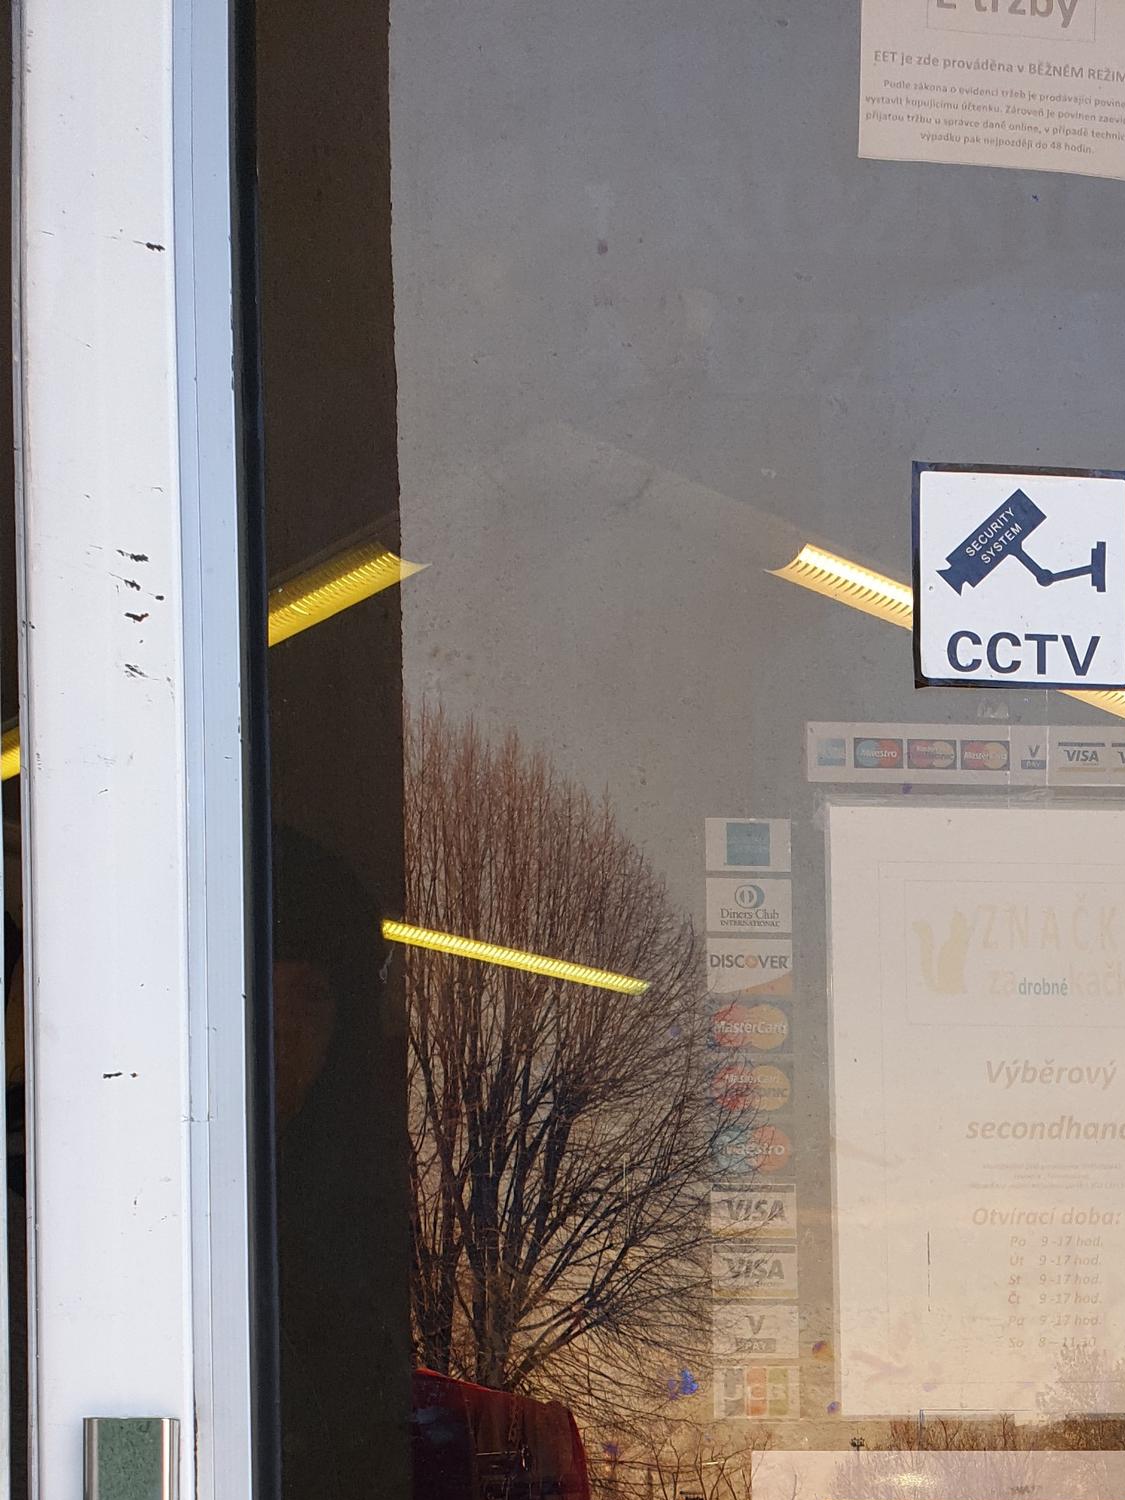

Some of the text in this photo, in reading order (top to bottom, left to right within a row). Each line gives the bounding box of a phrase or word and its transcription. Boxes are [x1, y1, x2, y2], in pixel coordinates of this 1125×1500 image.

[874, 50, 897, 64] EET
[900, 53, 914, 67] je
[916, 53, 939, 67] zde
[943, 55, 1014, 74] prováděna
[1017, 64, 1025, 73] v
[1028, 60, 1084, 79] BĚŽNÉM
[959, 85, 998, 98] evidenci
[1028, 90, 1037, 102] je
[865, 95, 902, 107] vystavit
[1046, 107, 1055, 120] je
[1058, 109, 1096, 124] povinen
[920, 131, 960, 146] výpadku
[963, 135, 982, 146] pak
[1035, 141, 1048, 151] do
[1050, 142, 1062, 152] 48
[965, 507, 1016, 557] SECURITY
[980, 522, 1023, 564] SYSTEM
[946, 630, 1101, 676] CCTV
[1063, 748, 1100, 763] VISA
[720, 908, 779, 920] Diners Club
[710, 953, 788, 969] DISCOVER
[1018, 976, 1069, 997] drobné
[986, 1059, 1117, 1090] Výběrový
[721, 1199, 786, 1222] VISA
[1061, 1207, 1121, 1226] doba:
[1041, 1236, 1049, 1247] 9
[722, 1257, 785, 1280] VISA
[1039, 1255, 1047, 1266] 9
[1039, 1274, 1047, 1285] 9
[1039, 1293, 1047, 1304] 9
[1039, 1315, 1047, 1326] 9
